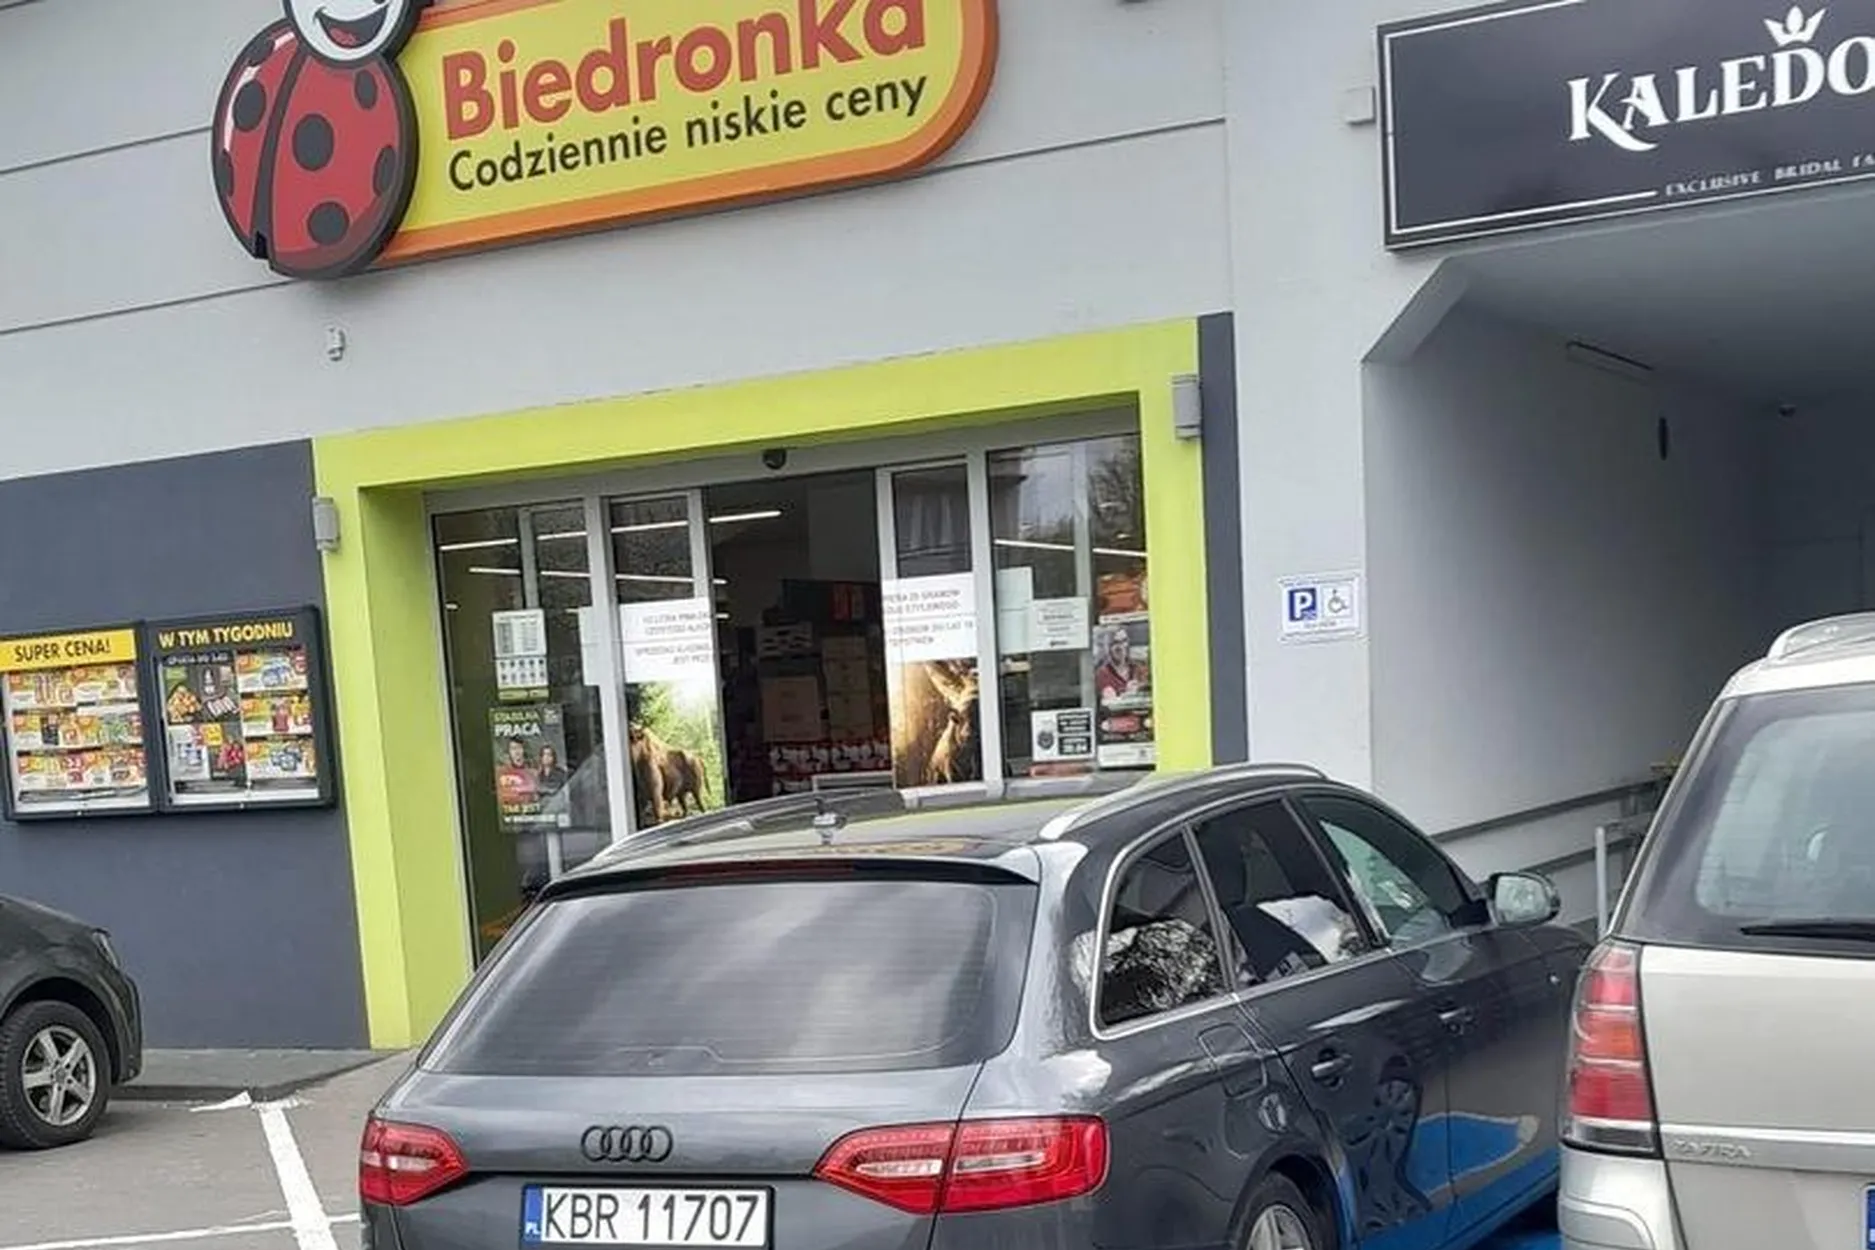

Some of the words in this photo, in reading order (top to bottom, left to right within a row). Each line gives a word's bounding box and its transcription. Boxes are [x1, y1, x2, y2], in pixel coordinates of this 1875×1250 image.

[442, 0, 926, 140] Biedronka
[449, 114, 668, 191] Codziennie
[686, 90, 807, 148] niskie
[826, 75, 928, 121] ceny
[1665, 170, 1762, 196] EXCLUSIVE
[1774, 158, 1842, 181] BRIDAL
[1293, 591, 1313, 619] P
[15, 642, 62, 663] SUPER
[65, 639, 111, 658] CENA!
[159, 631, 175, 649] W
[178, 629, 210, 647] TYM
[212, 621, 294, 643] TYGODNIU
[495, 722, 541, 737] PRACA
[545, 1193, 620, 1239] KBR
[638, 1194, 760, 1241] 11707
